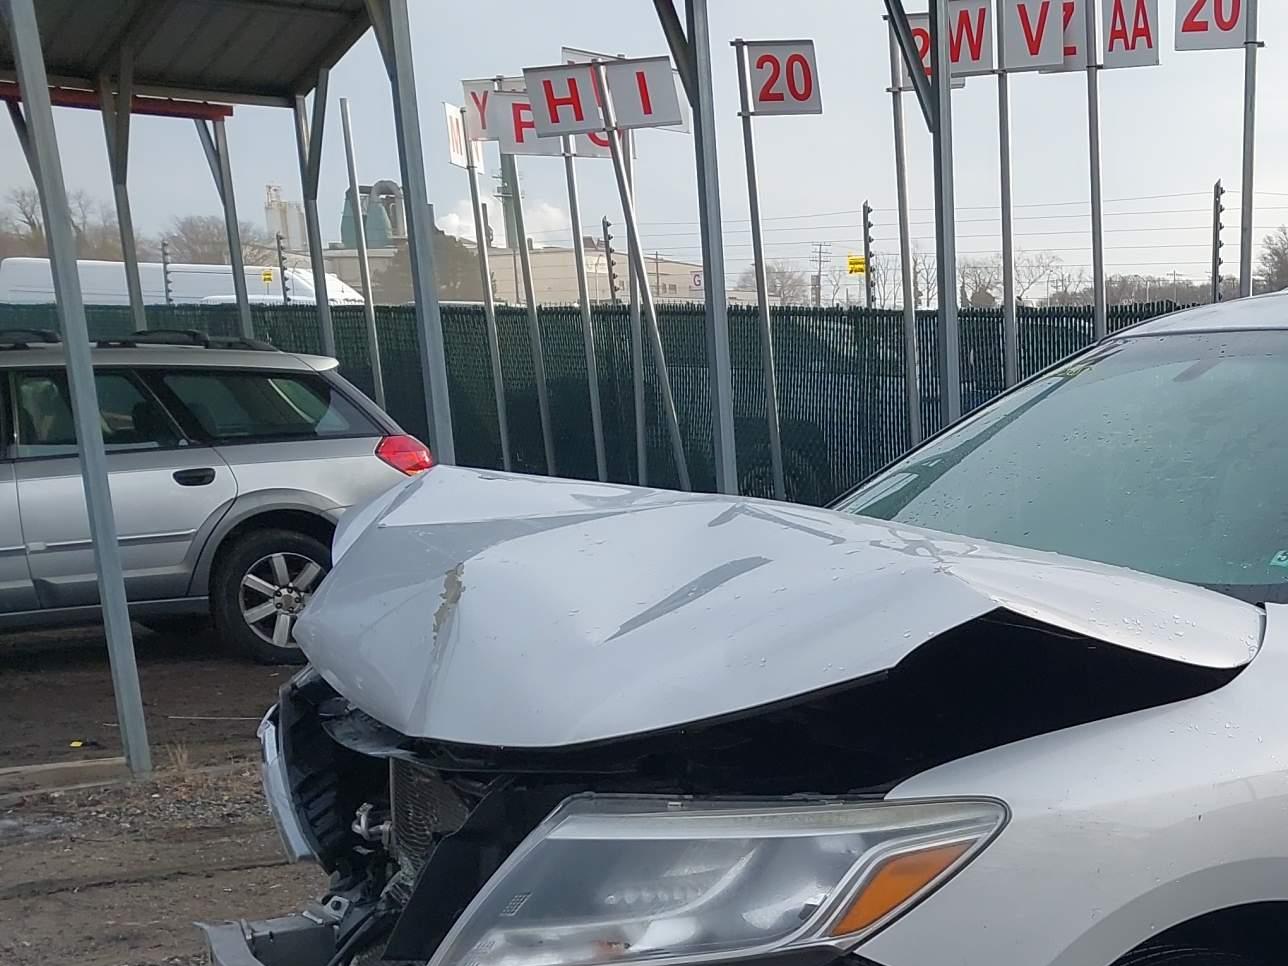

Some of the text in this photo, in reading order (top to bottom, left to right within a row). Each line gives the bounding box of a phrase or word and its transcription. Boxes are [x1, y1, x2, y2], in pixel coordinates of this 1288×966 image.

[948, 7, 987, 63] W
[1017, 1, 1050, 56] V
[1108, 0, 1153, 52] AA
[542, 79, 585, 124] H
[635, 71, 653, 115] I
[755, 53, 813, 102] 20
[470, 90, 489, 130] Y
